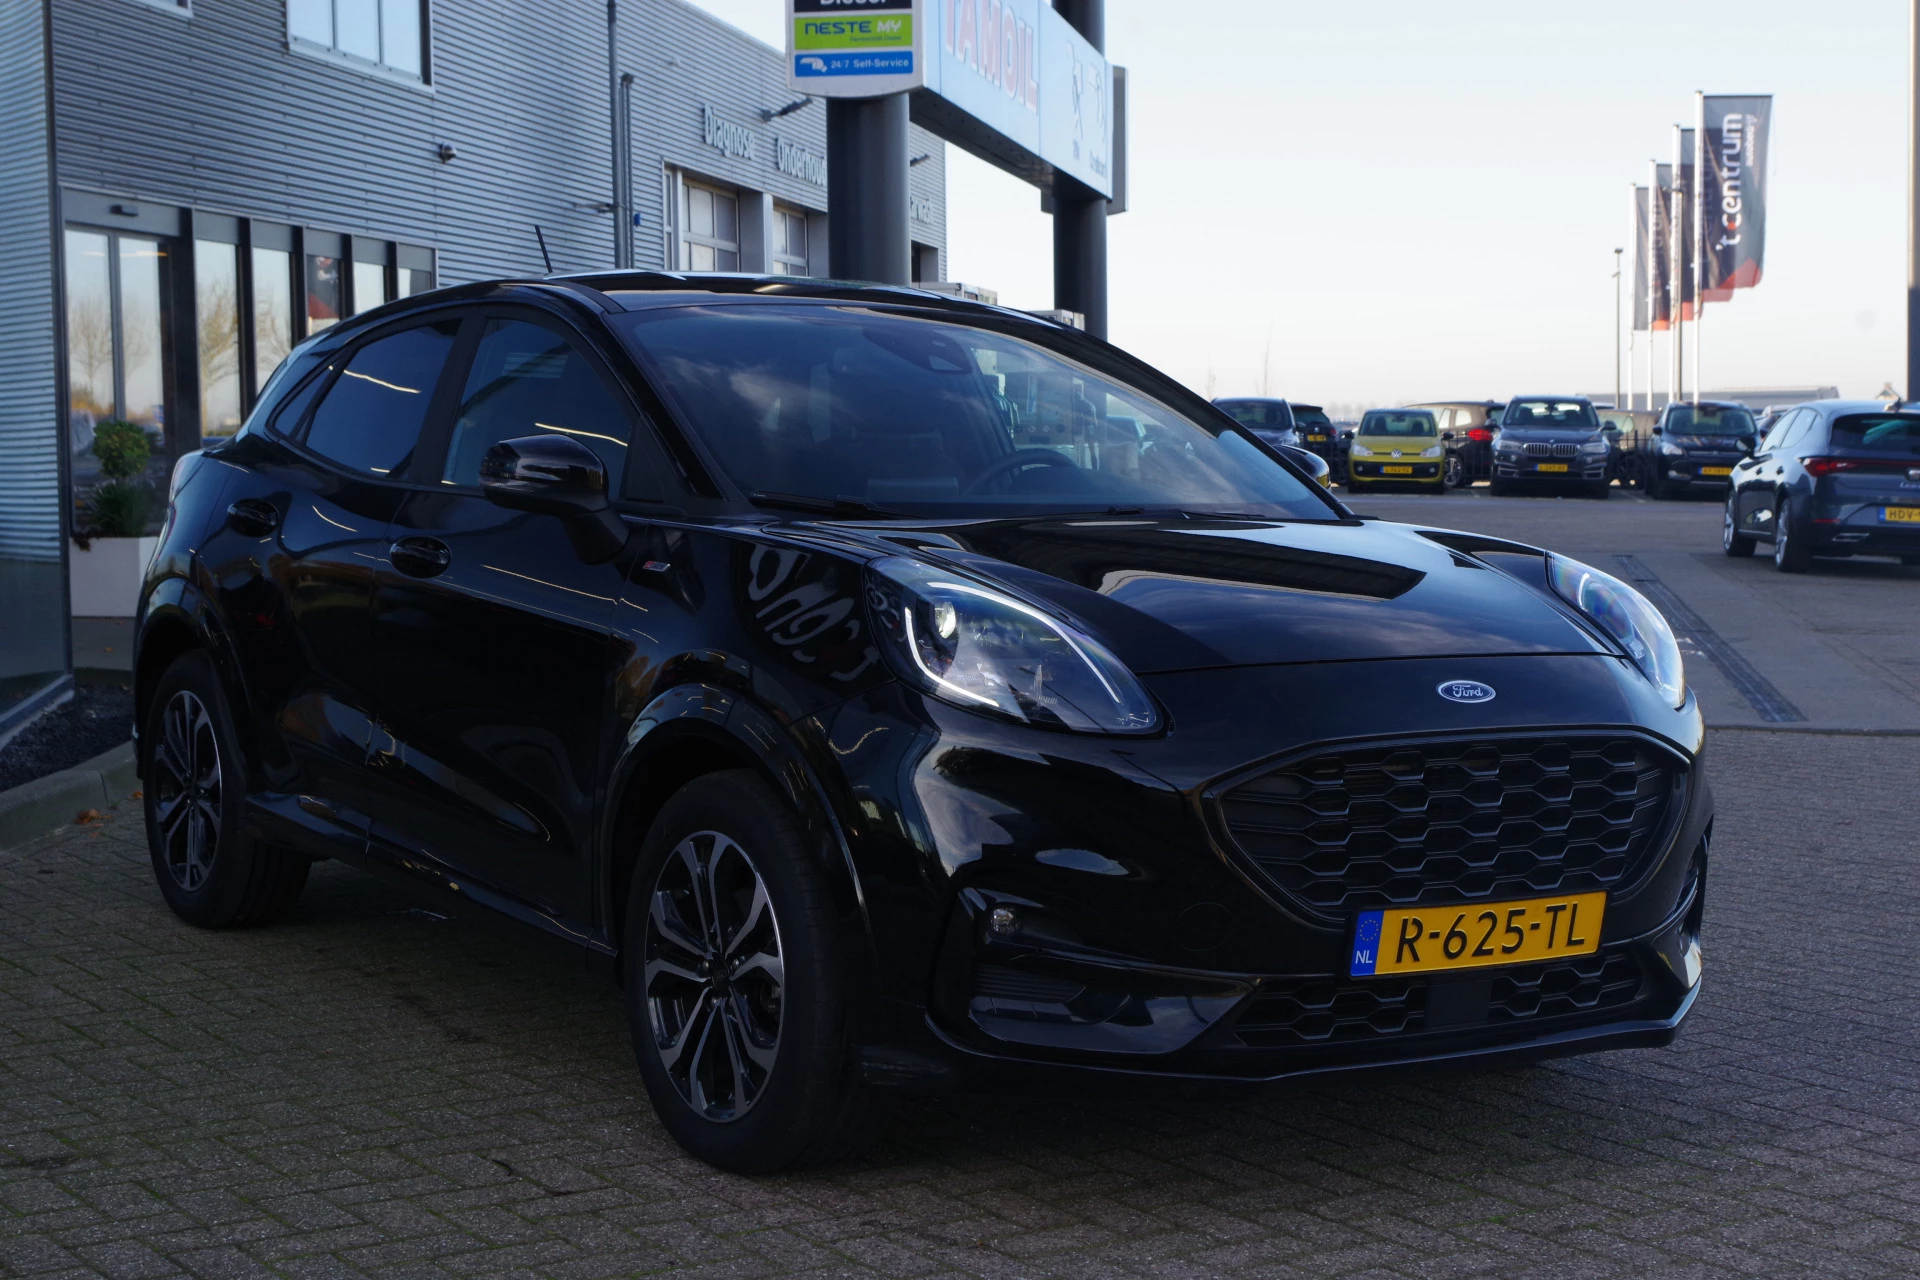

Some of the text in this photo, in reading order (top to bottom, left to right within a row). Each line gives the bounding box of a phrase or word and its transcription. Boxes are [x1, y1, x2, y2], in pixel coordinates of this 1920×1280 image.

[804, 19, 902, 35] NESTE MY
[831, 58, 909, 69] 24/7 Self-Service
[703, 103, 755, 160] Diagnose
[1721, 113, 1743, 231] centrum
[1889, 509, 1920, 519] HDV-
[1451, 683, 1484, 699] Ford
[1395, 901, 1586, 965] R-625-TL
[1355, 949, 1374, 965] NL
